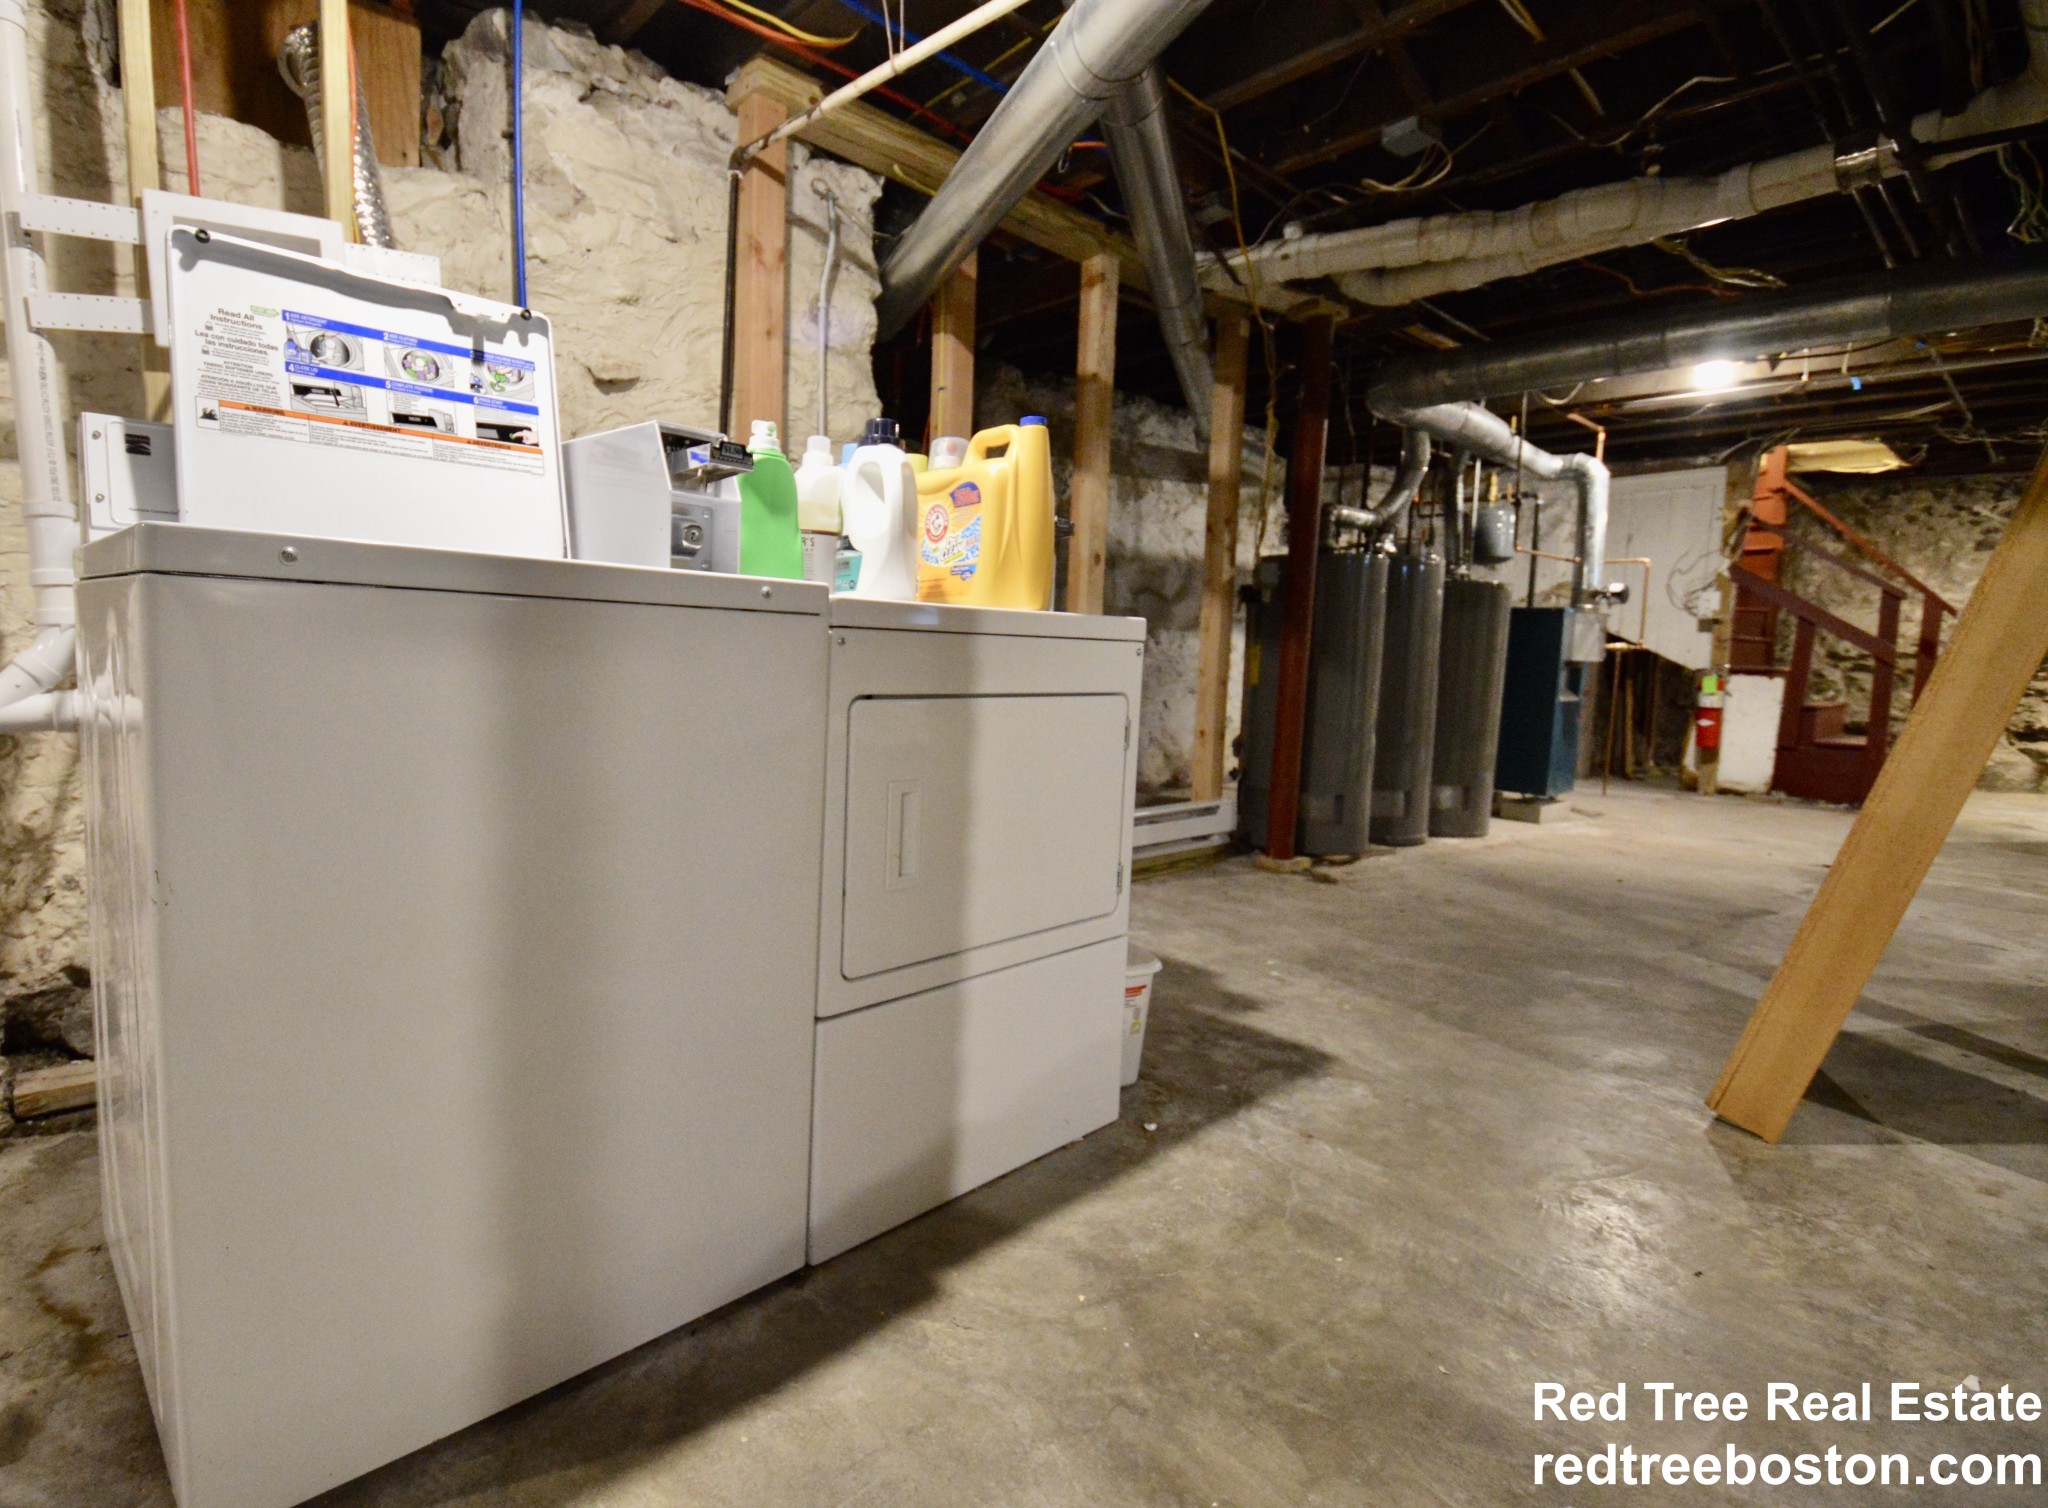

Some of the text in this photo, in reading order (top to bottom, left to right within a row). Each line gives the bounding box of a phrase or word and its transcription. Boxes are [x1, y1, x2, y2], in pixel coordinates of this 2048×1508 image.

[218, 308, 241, 318] Read
[285, 312, 290, 320] 1
[210, 314, 262, 330] Instructions
[194, 329, 208, 337] Lea
[226, 336, 256, 347] cuidado
[258, 342, 278, 351] todas
[383, 332, 388, 340] 2
[205, 338, 216, 346] las
[288, 364, 294, 372] 4
[386, 380, 392, 388] 5
